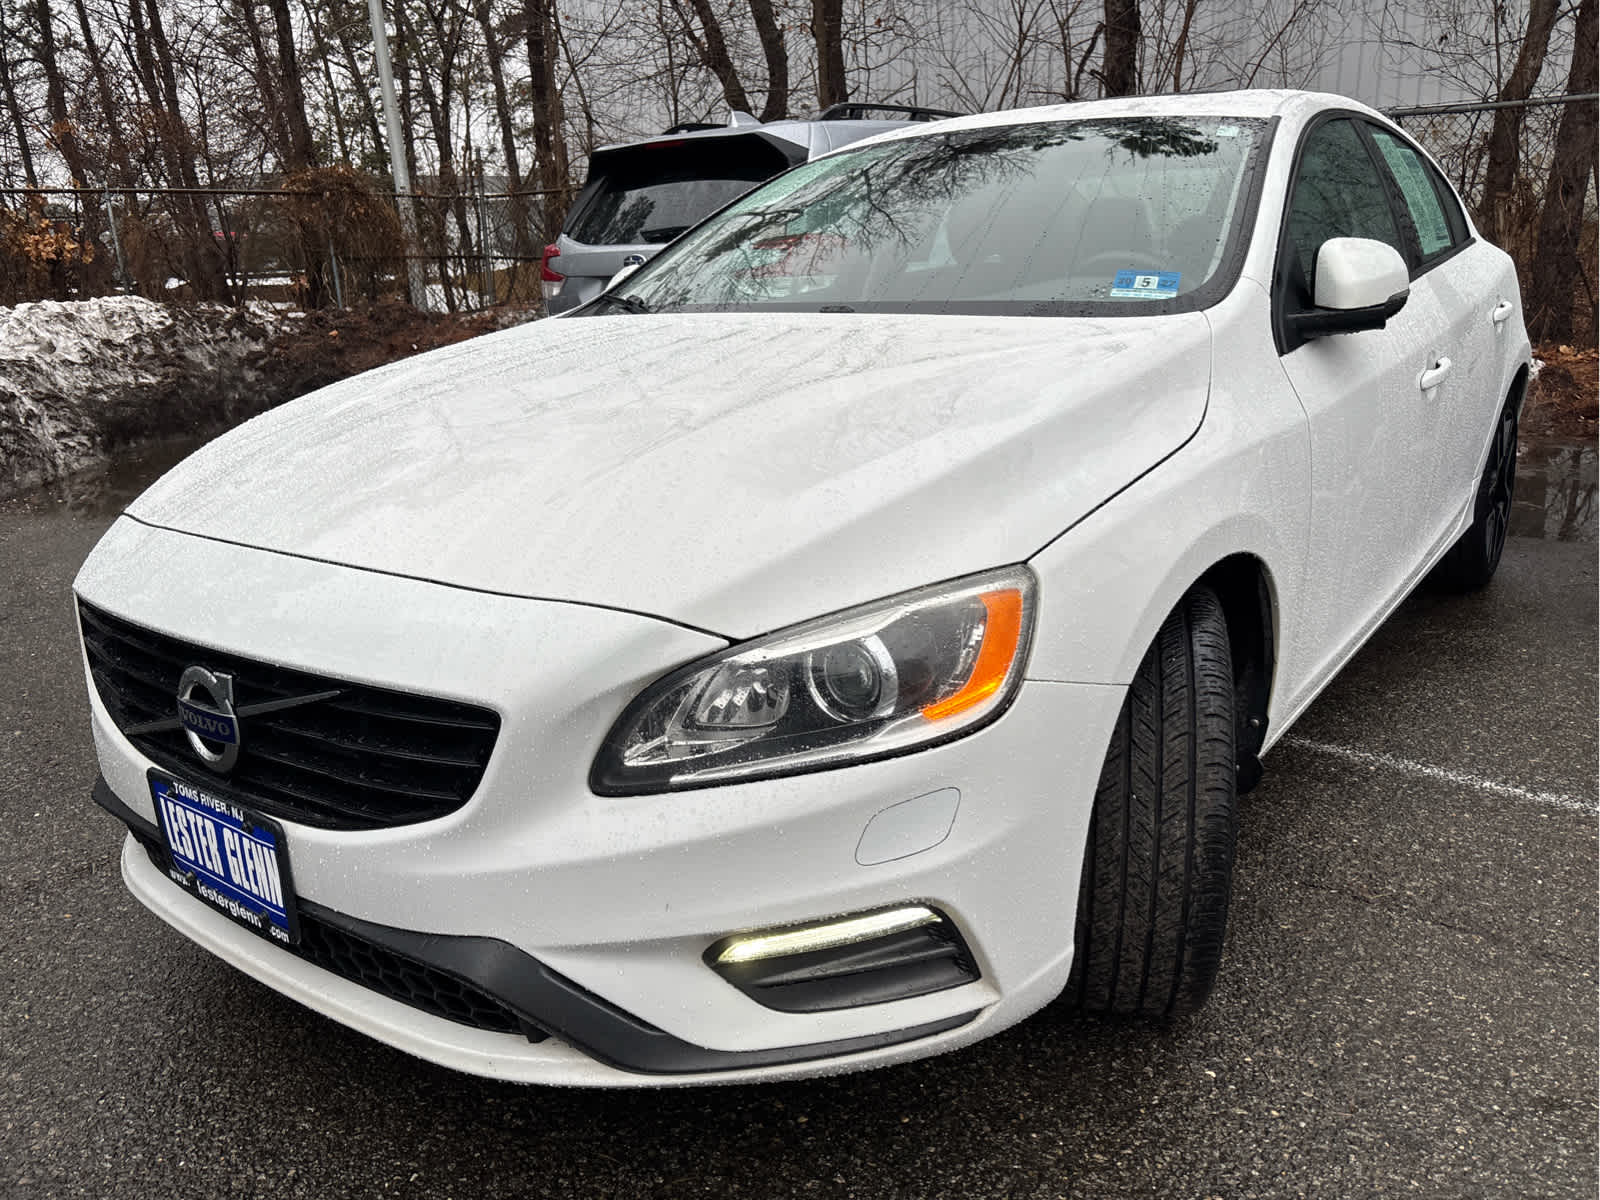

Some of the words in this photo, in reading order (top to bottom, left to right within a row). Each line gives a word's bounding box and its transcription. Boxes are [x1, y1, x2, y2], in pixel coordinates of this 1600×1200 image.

[1141, 277, 1152, 288] 5
[180, 704, 231, 736] VOLVO
[173, 781, 199, 803] TOMS
[231, 806, 244, 822] NJ
[160, 797, 225, 877] LESTER
[223, 827, 284, 909] GLENN
[197, 880, 262, 928] lesterglenn
